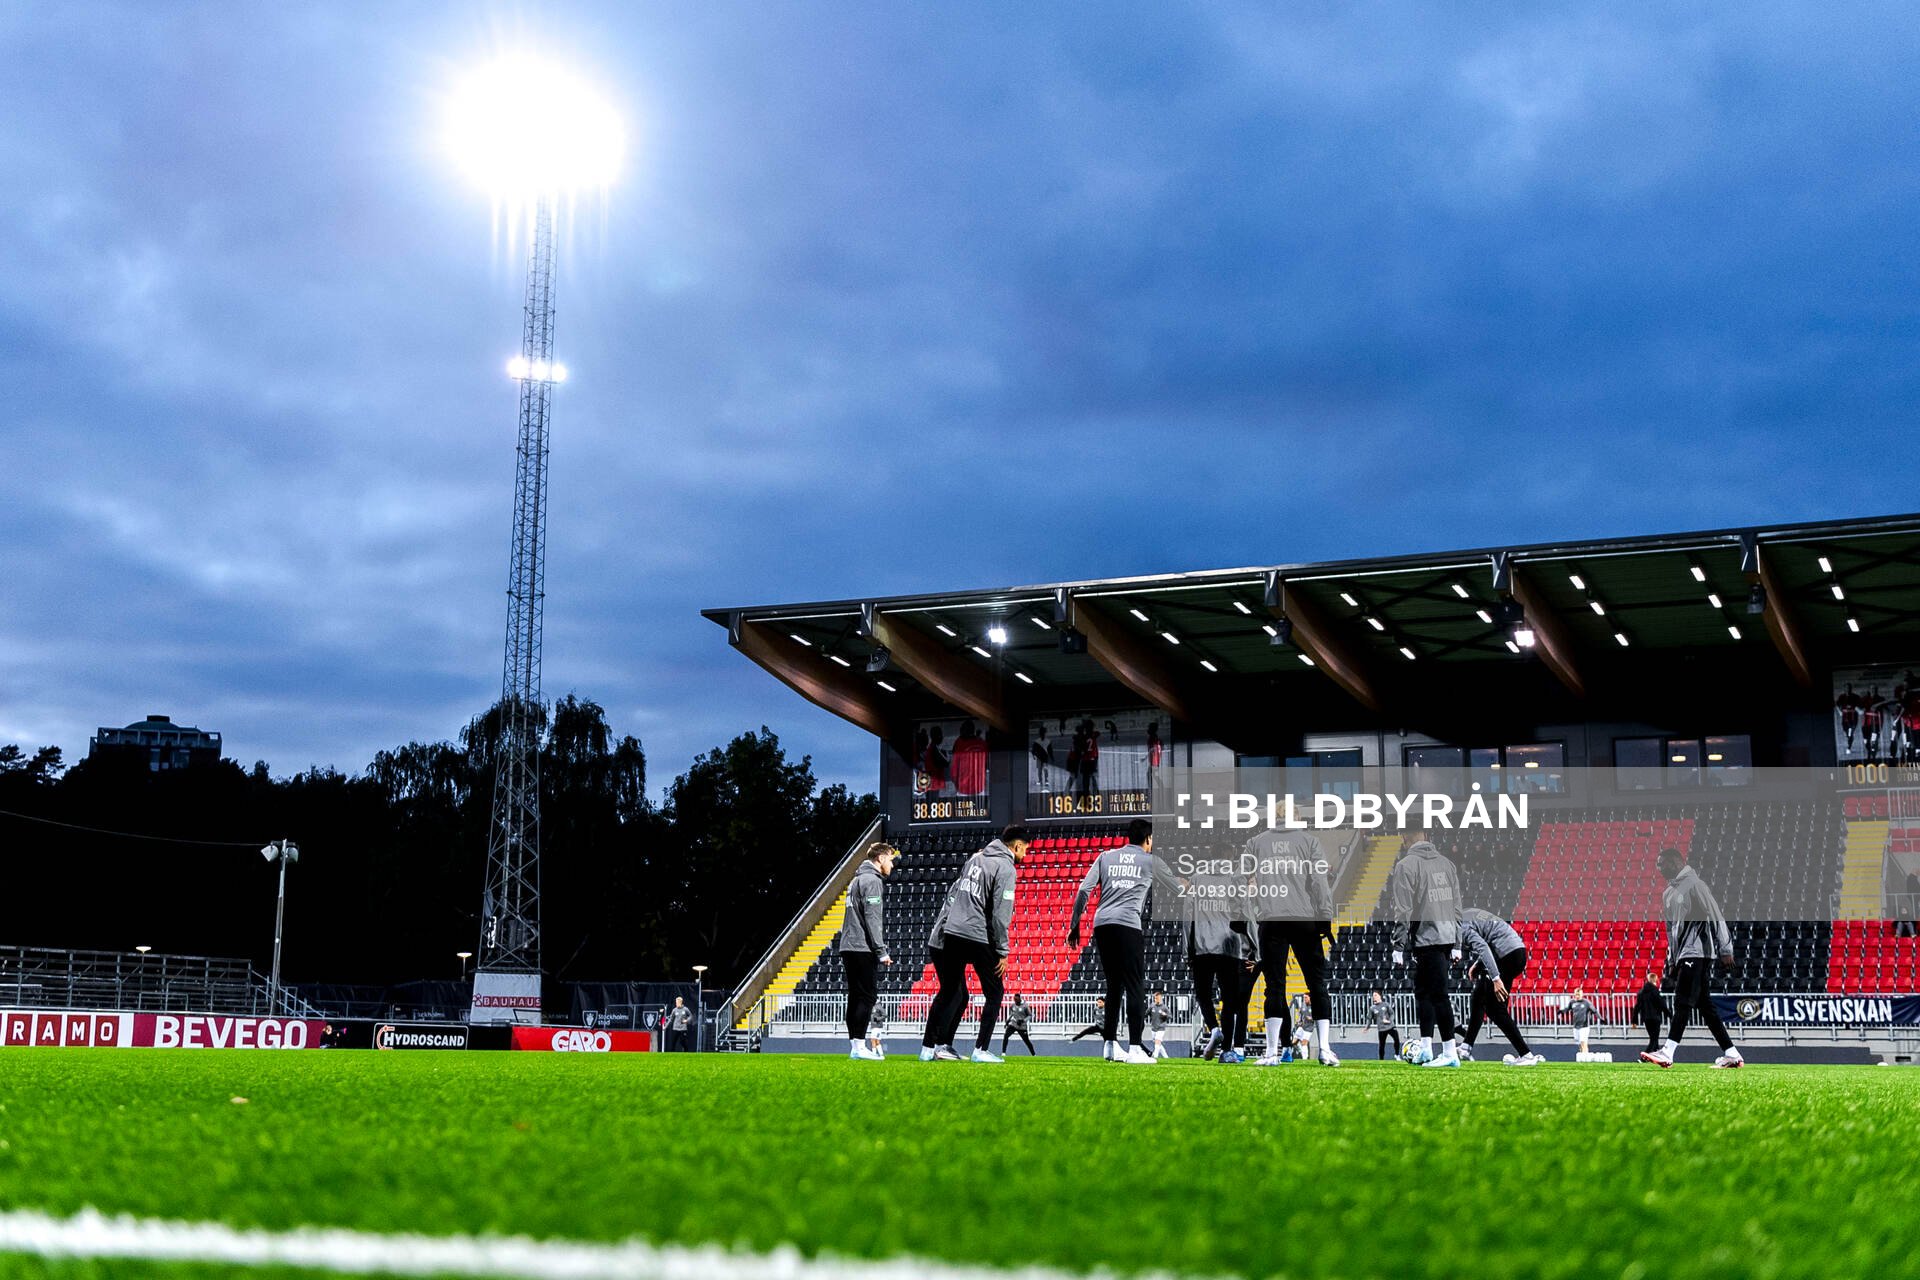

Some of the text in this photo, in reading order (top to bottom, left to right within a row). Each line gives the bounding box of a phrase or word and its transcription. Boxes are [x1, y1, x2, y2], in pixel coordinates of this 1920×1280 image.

[1847, 763, 1889, 784] 1000
[913, 802, 952, 819] 38.880
[1271, 840, 1290, 854] VSK
[1120, 853, 1136, 864] VSK
[1107, 864, 1142, 879] FOTBOLL
[483, 997, 541, 1007] BAUHAUS
[1761, 997, 1893, 1022] ALLSVENSKAN
[153, 1015, 308, 1049] BEVEGO
[383, 1032, 465, 1047] HYDROSCAND
[551, 1030, 612, 1052] GARO
